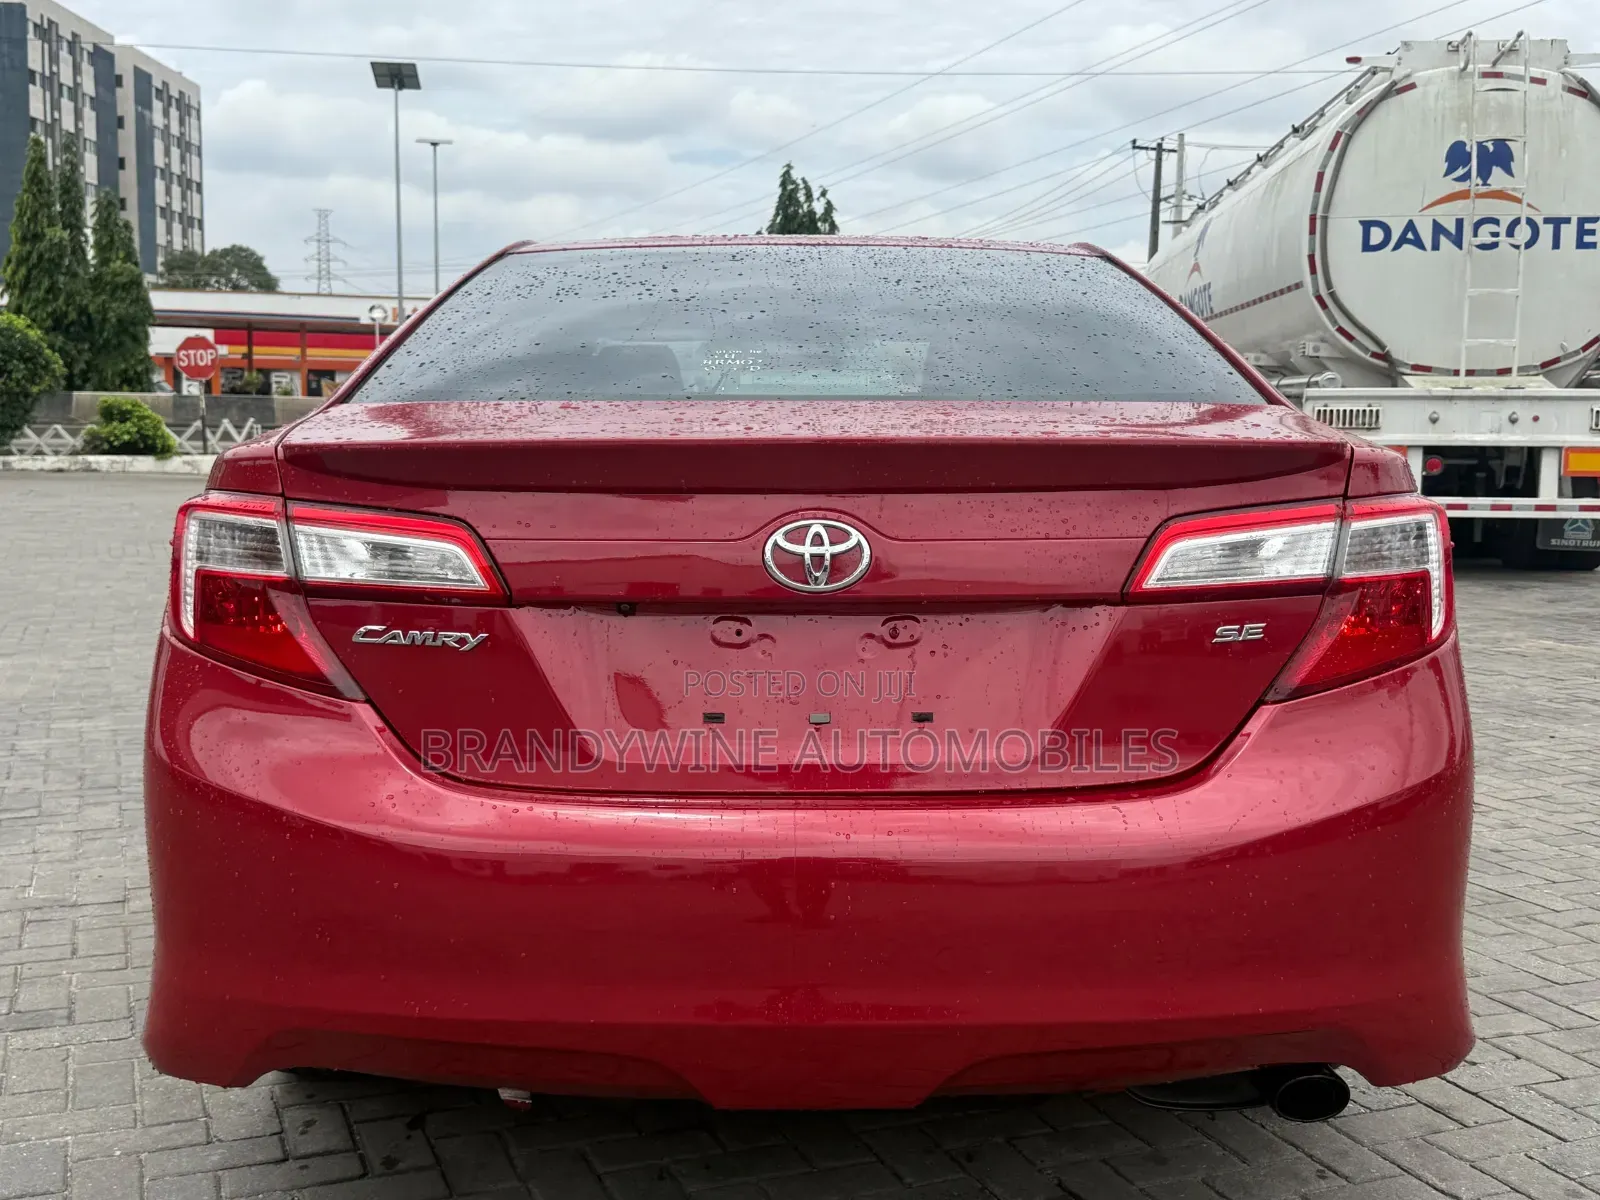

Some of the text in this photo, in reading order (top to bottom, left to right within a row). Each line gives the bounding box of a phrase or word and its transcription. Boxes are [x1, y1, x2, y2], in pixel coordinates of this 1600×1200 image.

[1358, 216, 1600, 252] DANGOTE
[179, 349, 217, 367] STOP
[352, 625, 489, 651] CAMRY
[1212, 623, 1267, 643] SE
